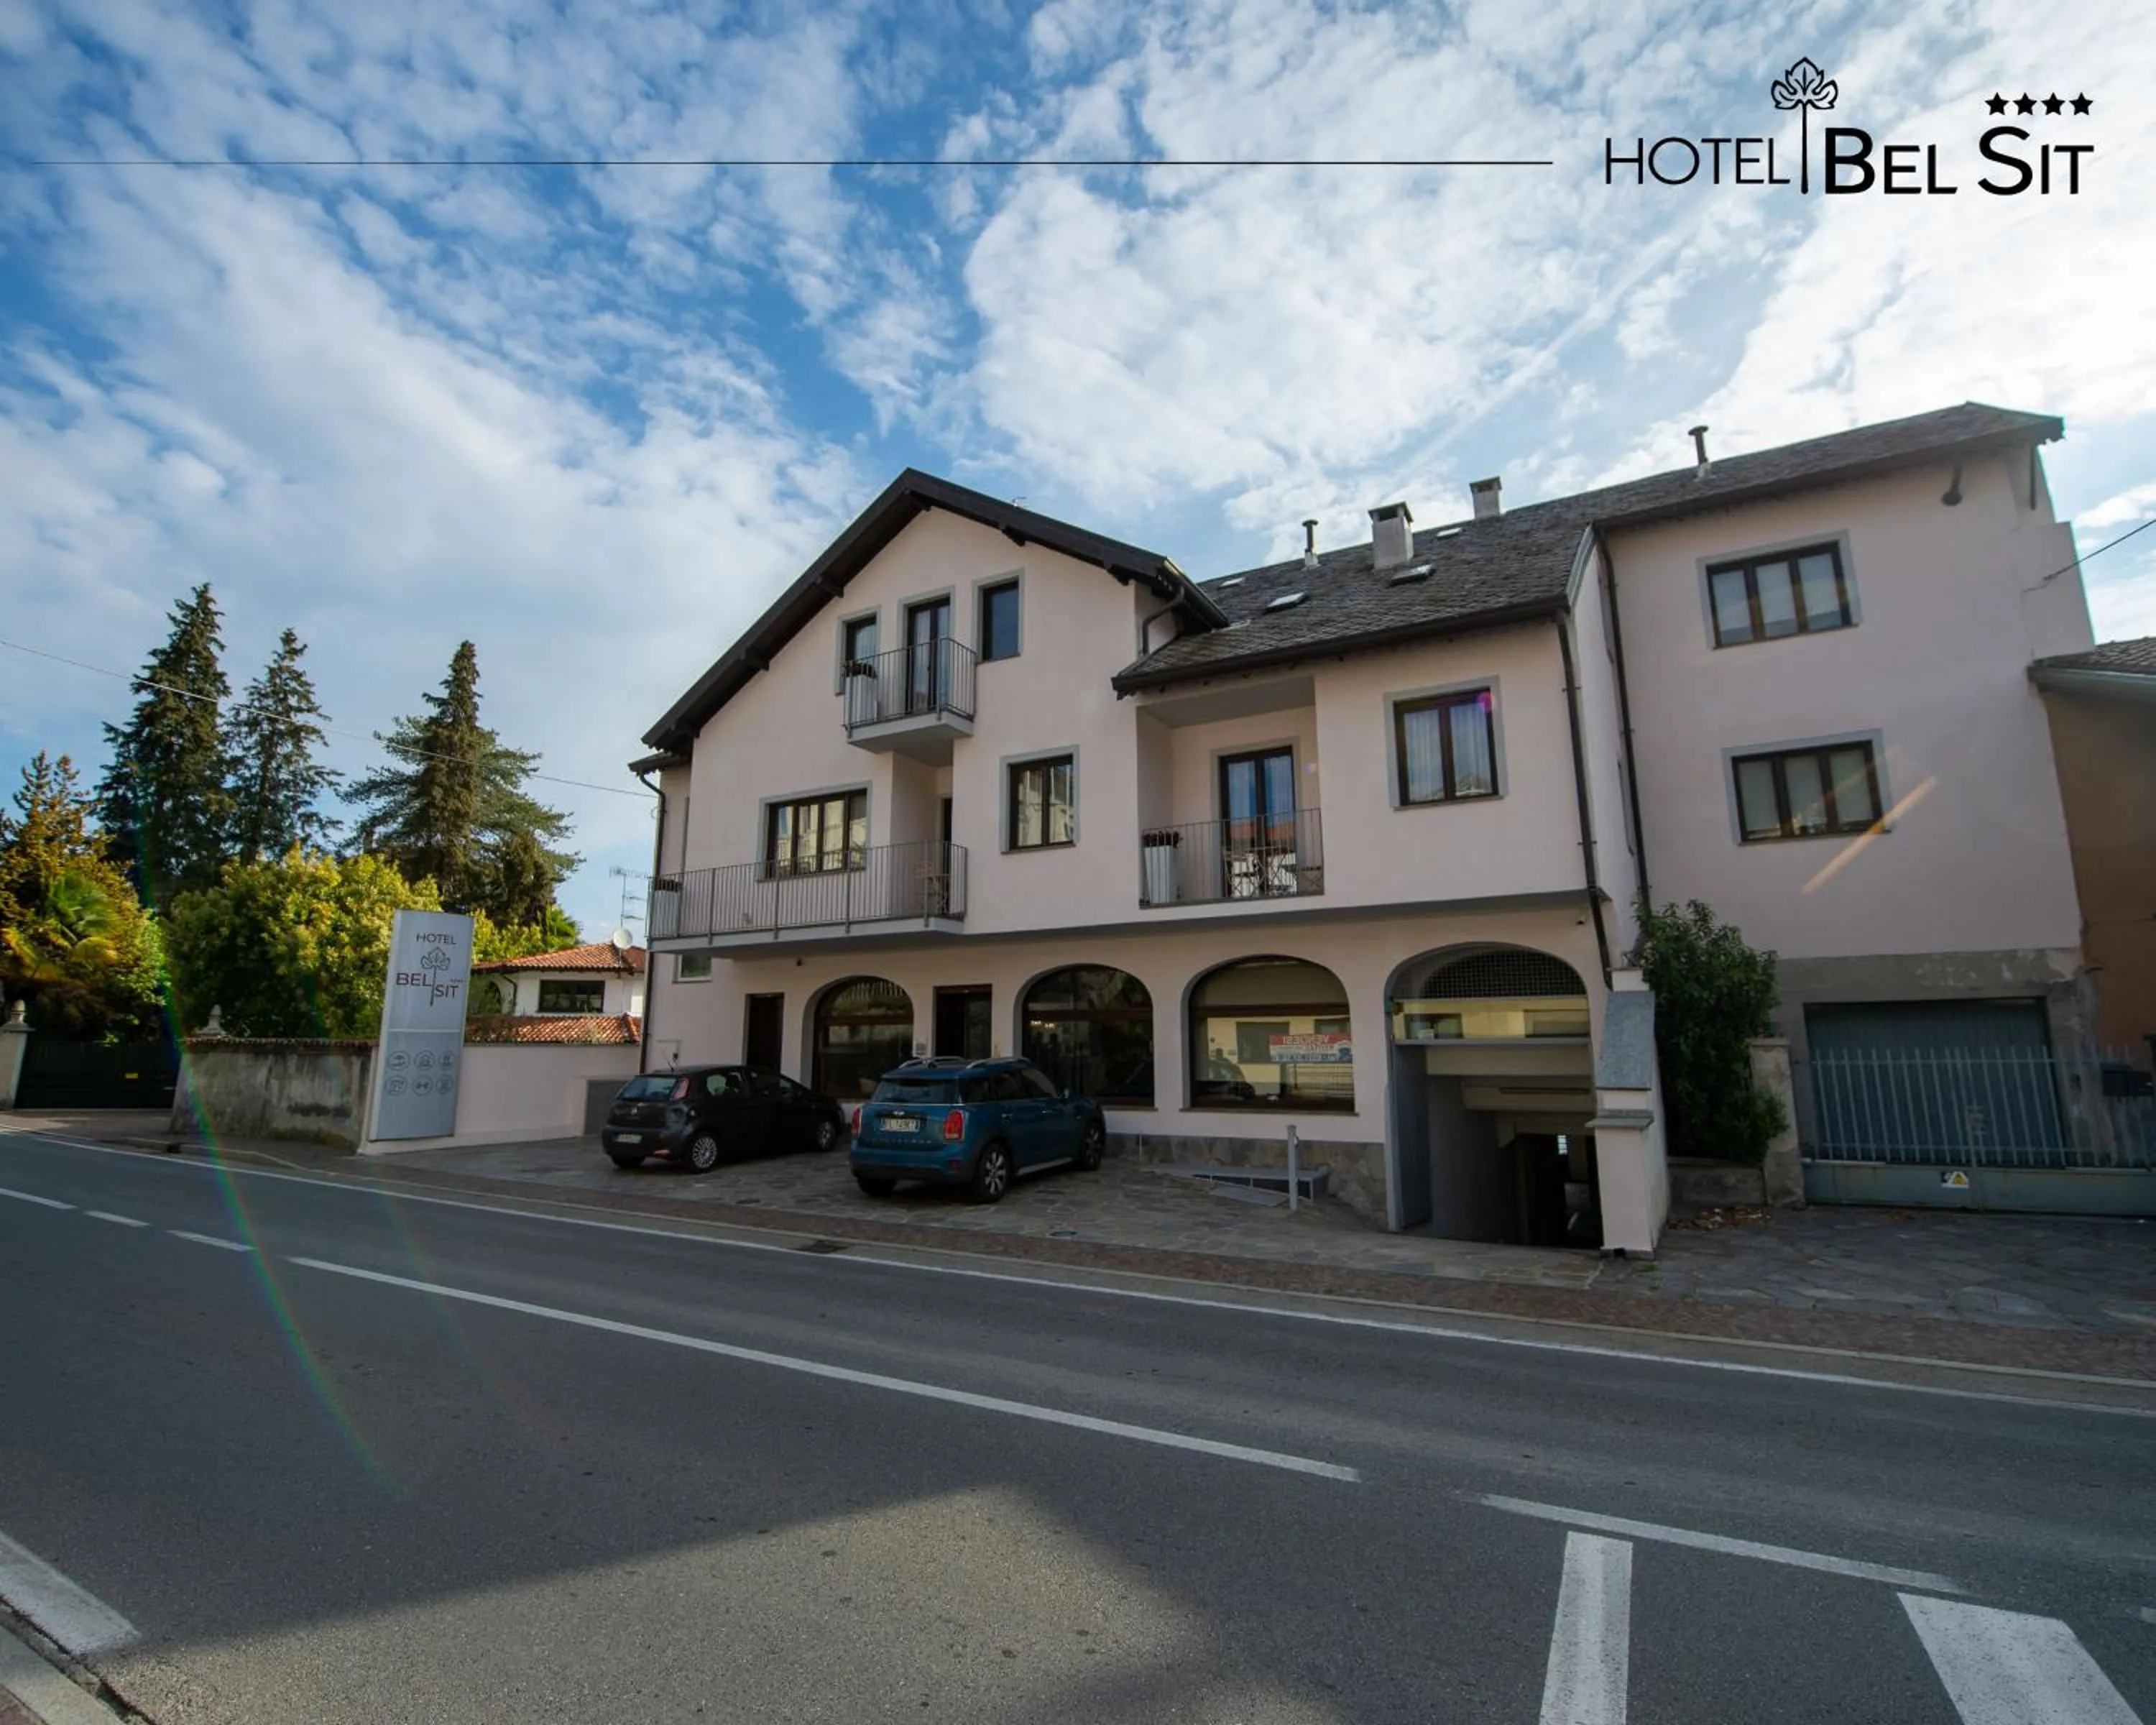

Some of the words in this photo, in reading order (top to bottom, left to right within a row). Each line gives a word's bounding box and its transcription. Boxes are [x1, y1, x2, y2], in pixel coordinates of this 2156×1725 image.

[416, 933, 456, 945] HOTEL
[396, 972, 433, 987] BEL
[435, 984, 459, 998] SIT
